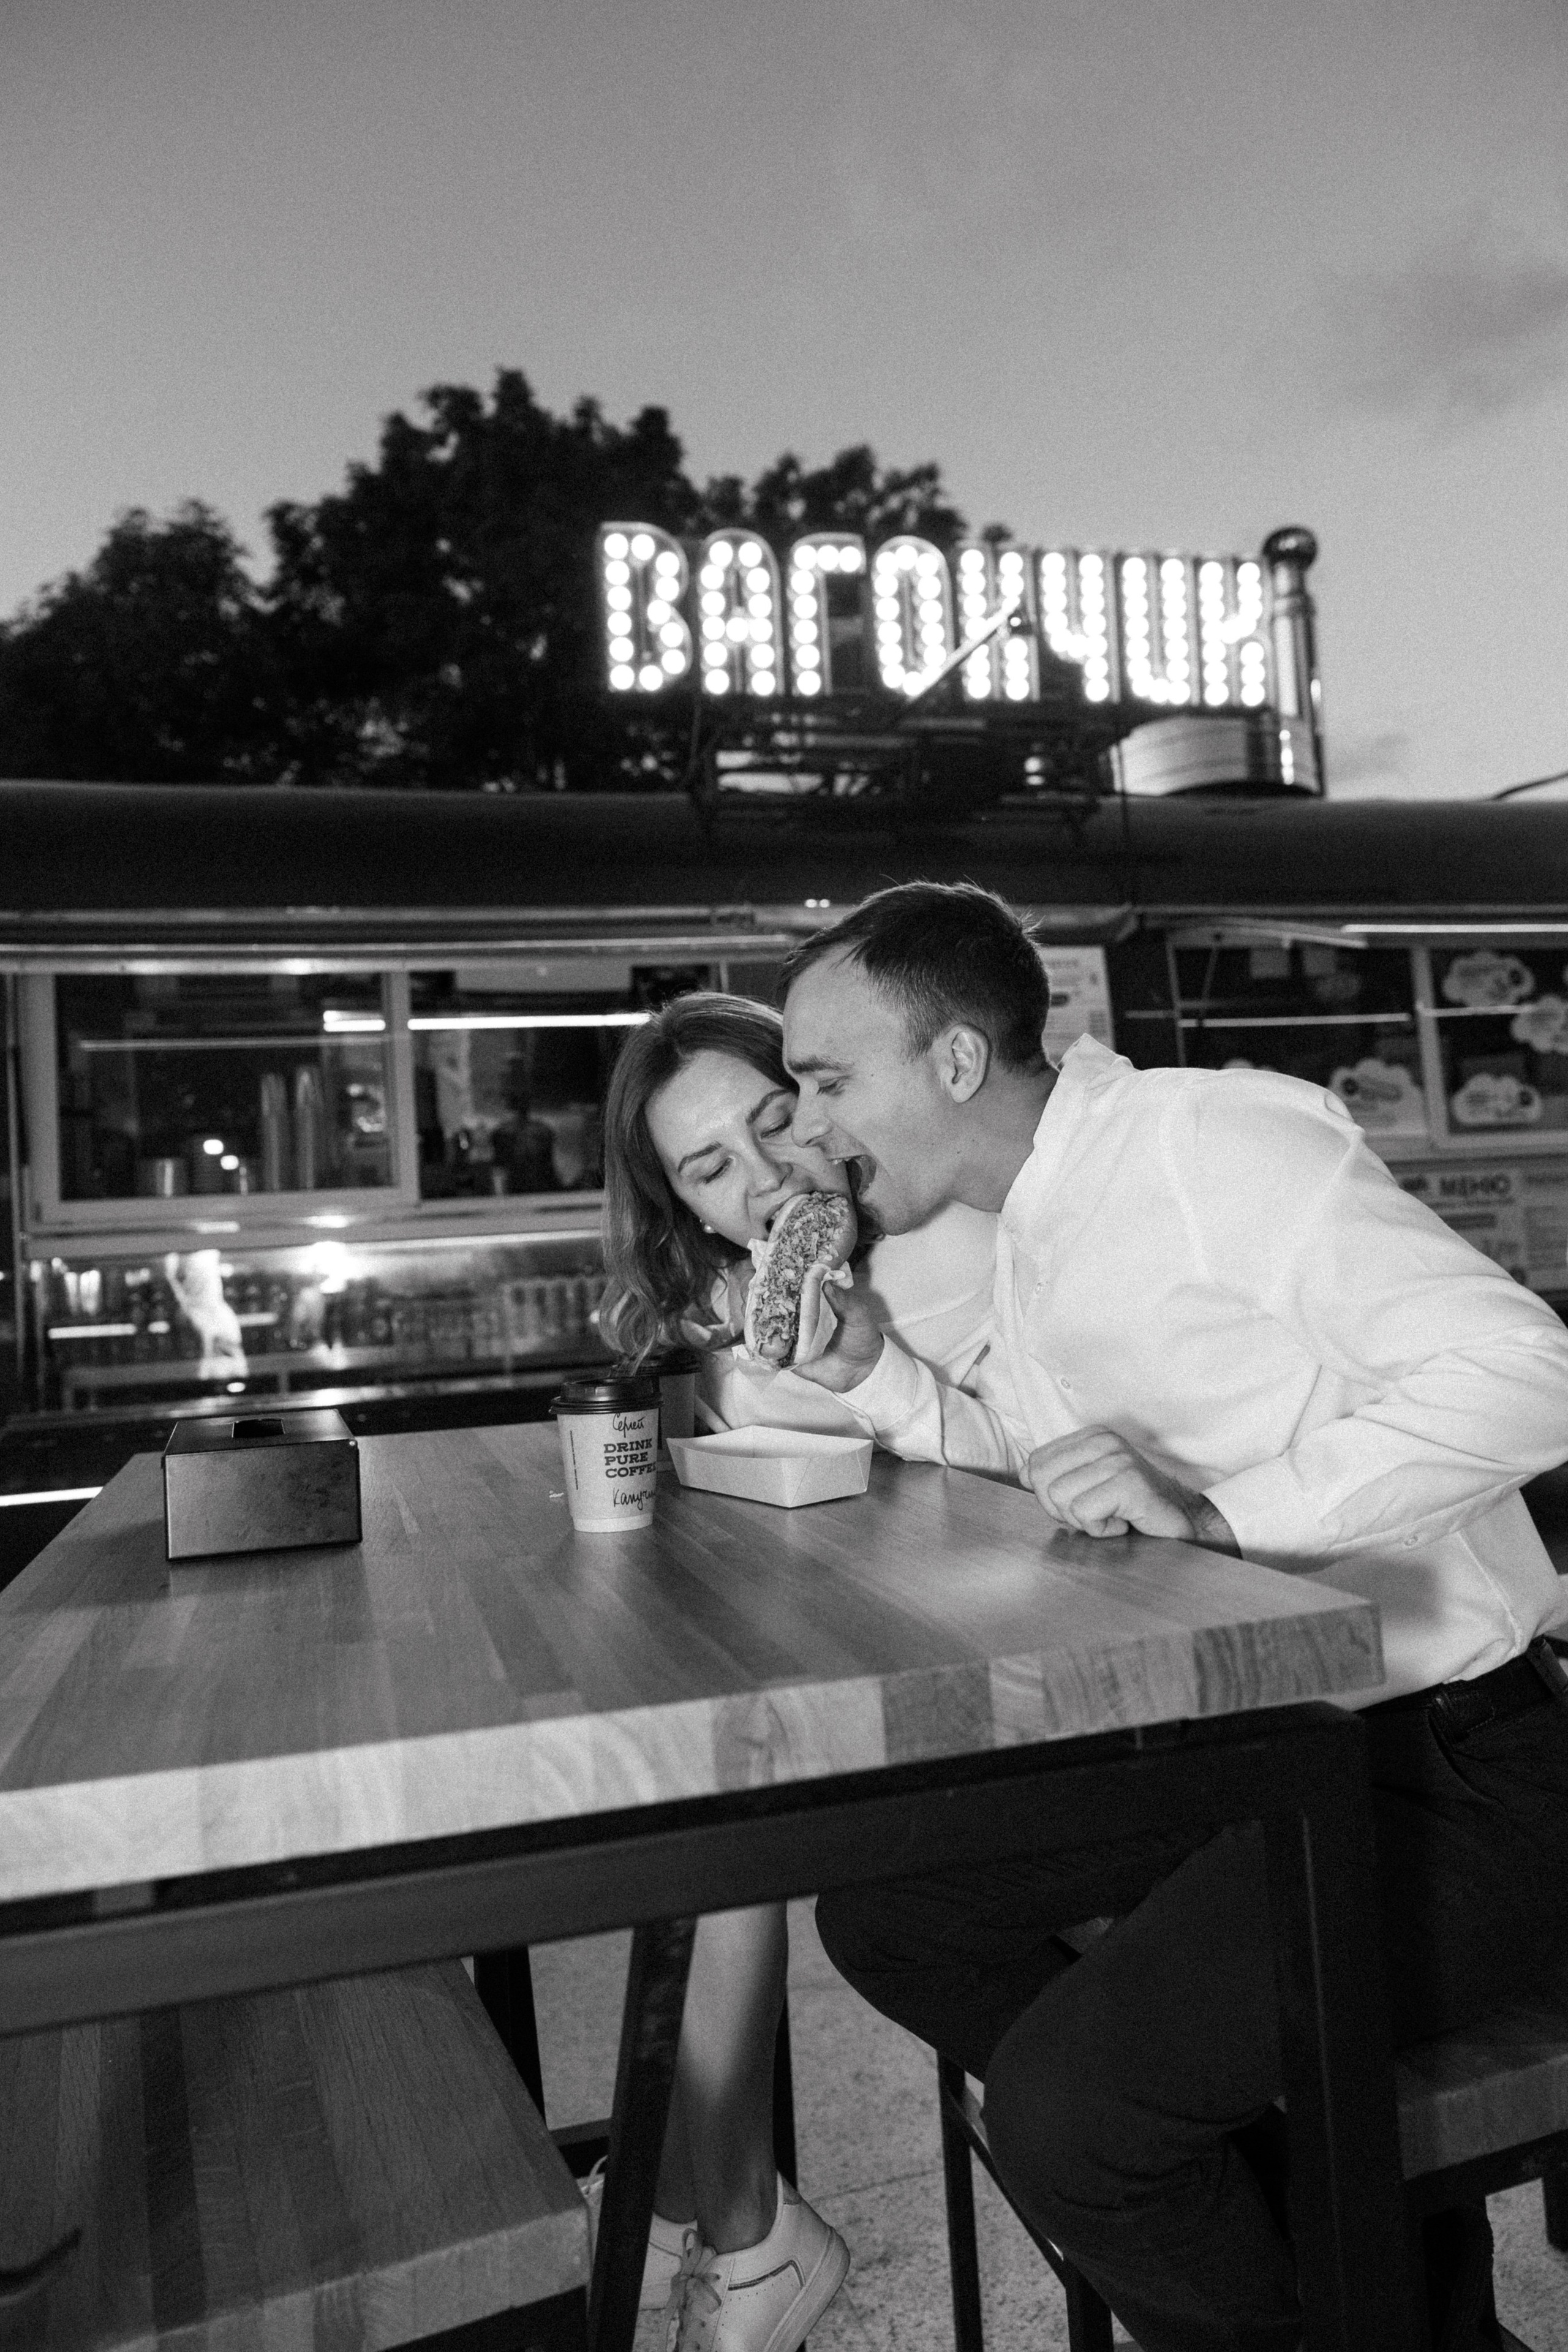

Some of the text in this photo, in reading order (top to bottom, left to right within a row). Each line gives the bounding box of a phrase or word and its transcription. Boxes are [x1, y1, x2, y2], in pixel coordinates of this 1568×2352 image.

[600, 521, 1269, 707] ВАГОНЧИК
[603, 1438, 652, 1453] DRINK
[605, 1452, 648, 1466] PURE
